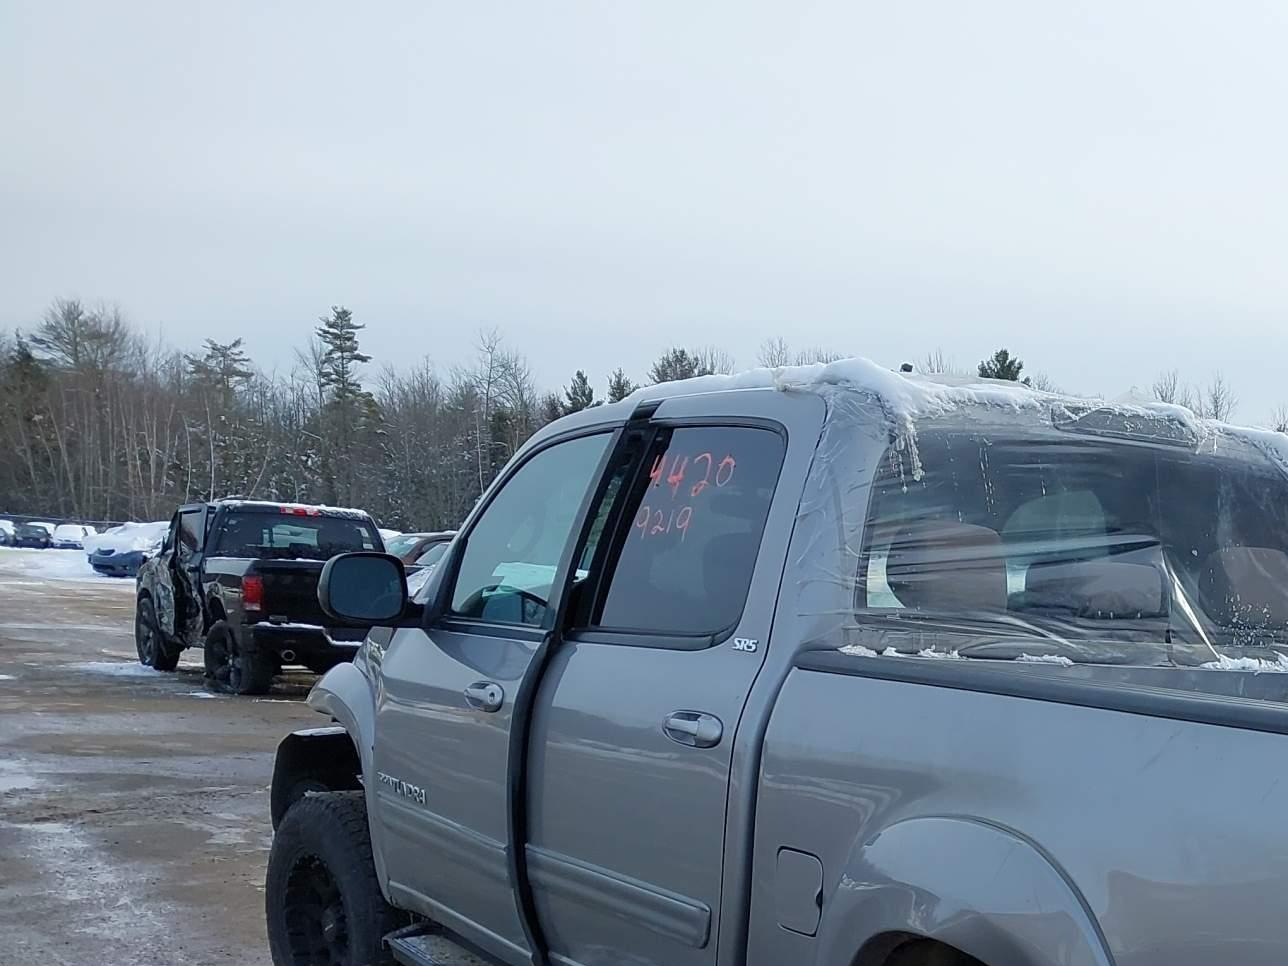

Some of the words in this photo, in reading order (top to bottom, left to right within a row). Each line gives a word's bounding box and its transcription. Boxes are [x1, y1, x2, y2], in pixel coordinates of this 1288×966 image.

[650, 453, 736, 500] 4420
[637, 506, 693, 542] 9219
[732, 637, 758, 651] SR5
